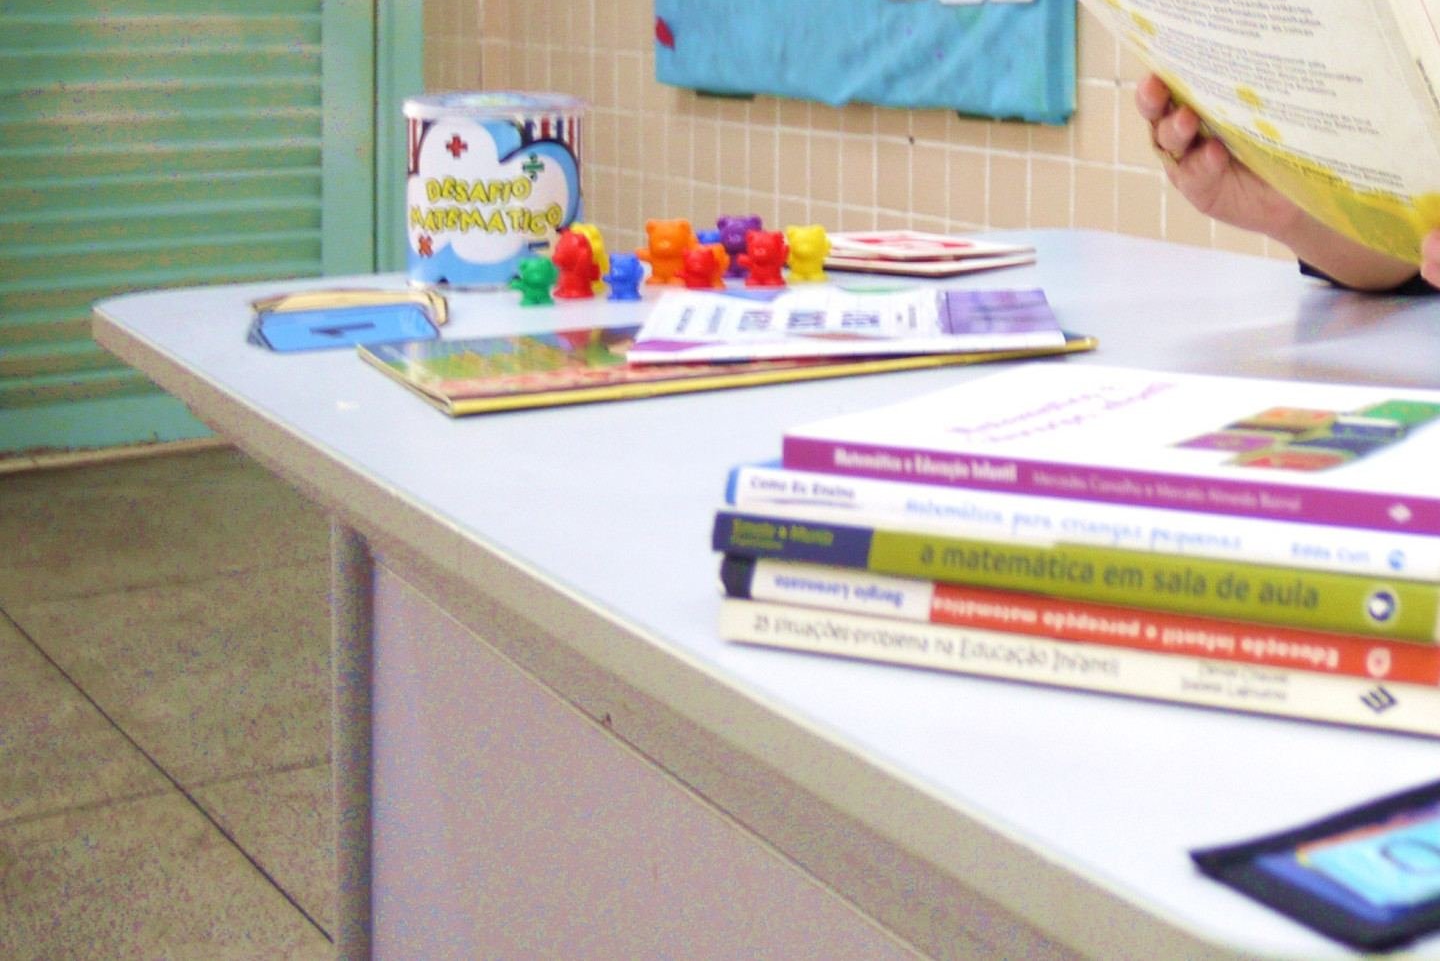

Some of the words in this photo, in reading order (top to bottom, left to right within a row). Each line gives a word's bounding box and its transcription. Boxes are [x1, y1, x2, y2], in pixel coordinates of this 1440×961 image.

[425, 175, 533, 204] DESAFIO
[750, 477, 787, 494] Como
[812, 482, 857, 501] Ensino
[1012, 512, 1052, 537] para
[1061, 516, 1142, 547] crianças
[1150, 525, 1243, 554] pequenas
[920, 545, 935, 567] a
[942, 544, 1096, 584] matemática
[1103, 562, 1145, 588] em
[1152, 565, 1207, 597] sala
[1215, 573, 1251, 602] de
[1258, 580, 1320, 610] aula
[959, 636, 1048, 668] Educação
